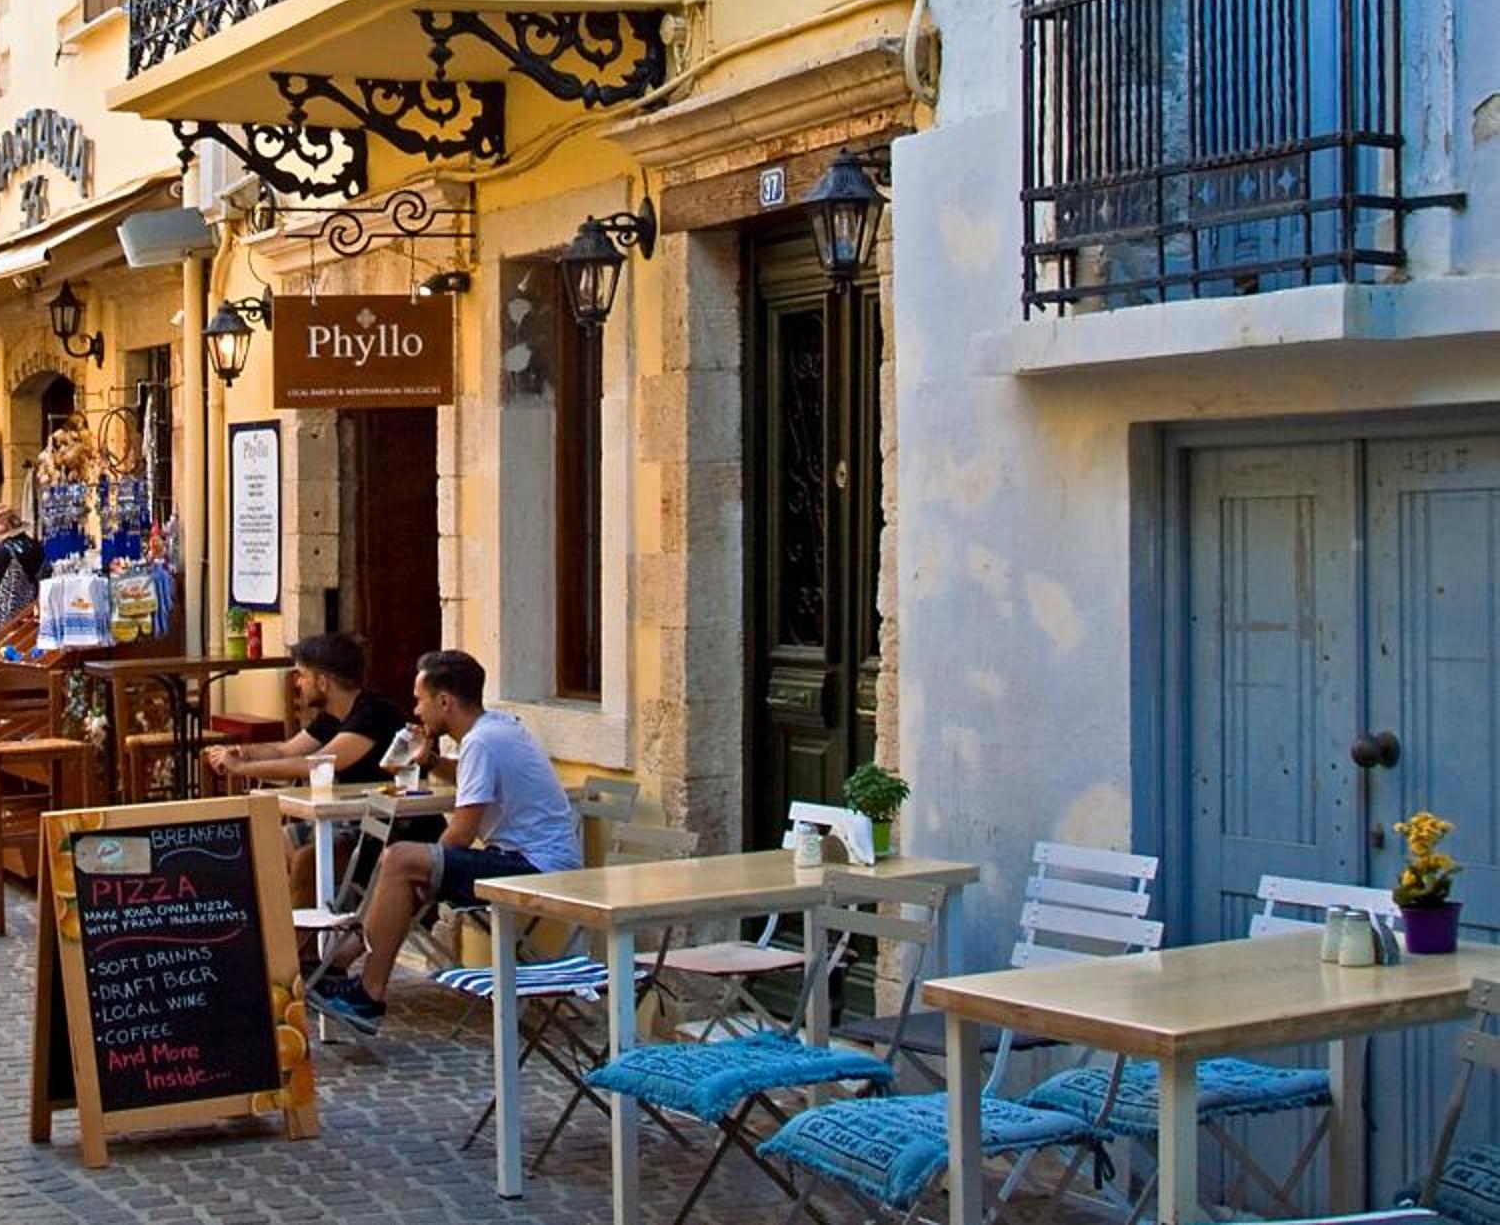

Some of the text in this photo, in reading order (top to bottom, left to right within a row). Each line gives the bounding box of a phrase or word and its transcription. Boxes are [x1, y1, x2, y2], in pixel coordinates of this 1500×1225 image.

[763, 174, 779, 201] 37
[307, 324, 423, 366] Phyllo
[150, 823, 241, 849] BREAKFAST
[92, 875, 197, 907] PIZZA
[84, 900, 232, 922] MAKE YOUR OWN PIZZA
[85, 922, 118, 936] WITH
[121, 917, 163, 931] FRESH
[98, 946, 213, 976] SOFT DRINKS
[99, 965, 219, 1001] DRAFT BEER
[101, 992, 208, 1024] LOCAL WINE
[104, 1022, 174, 1045] COFFEE
[108, 1042, 200, 1073] And More
